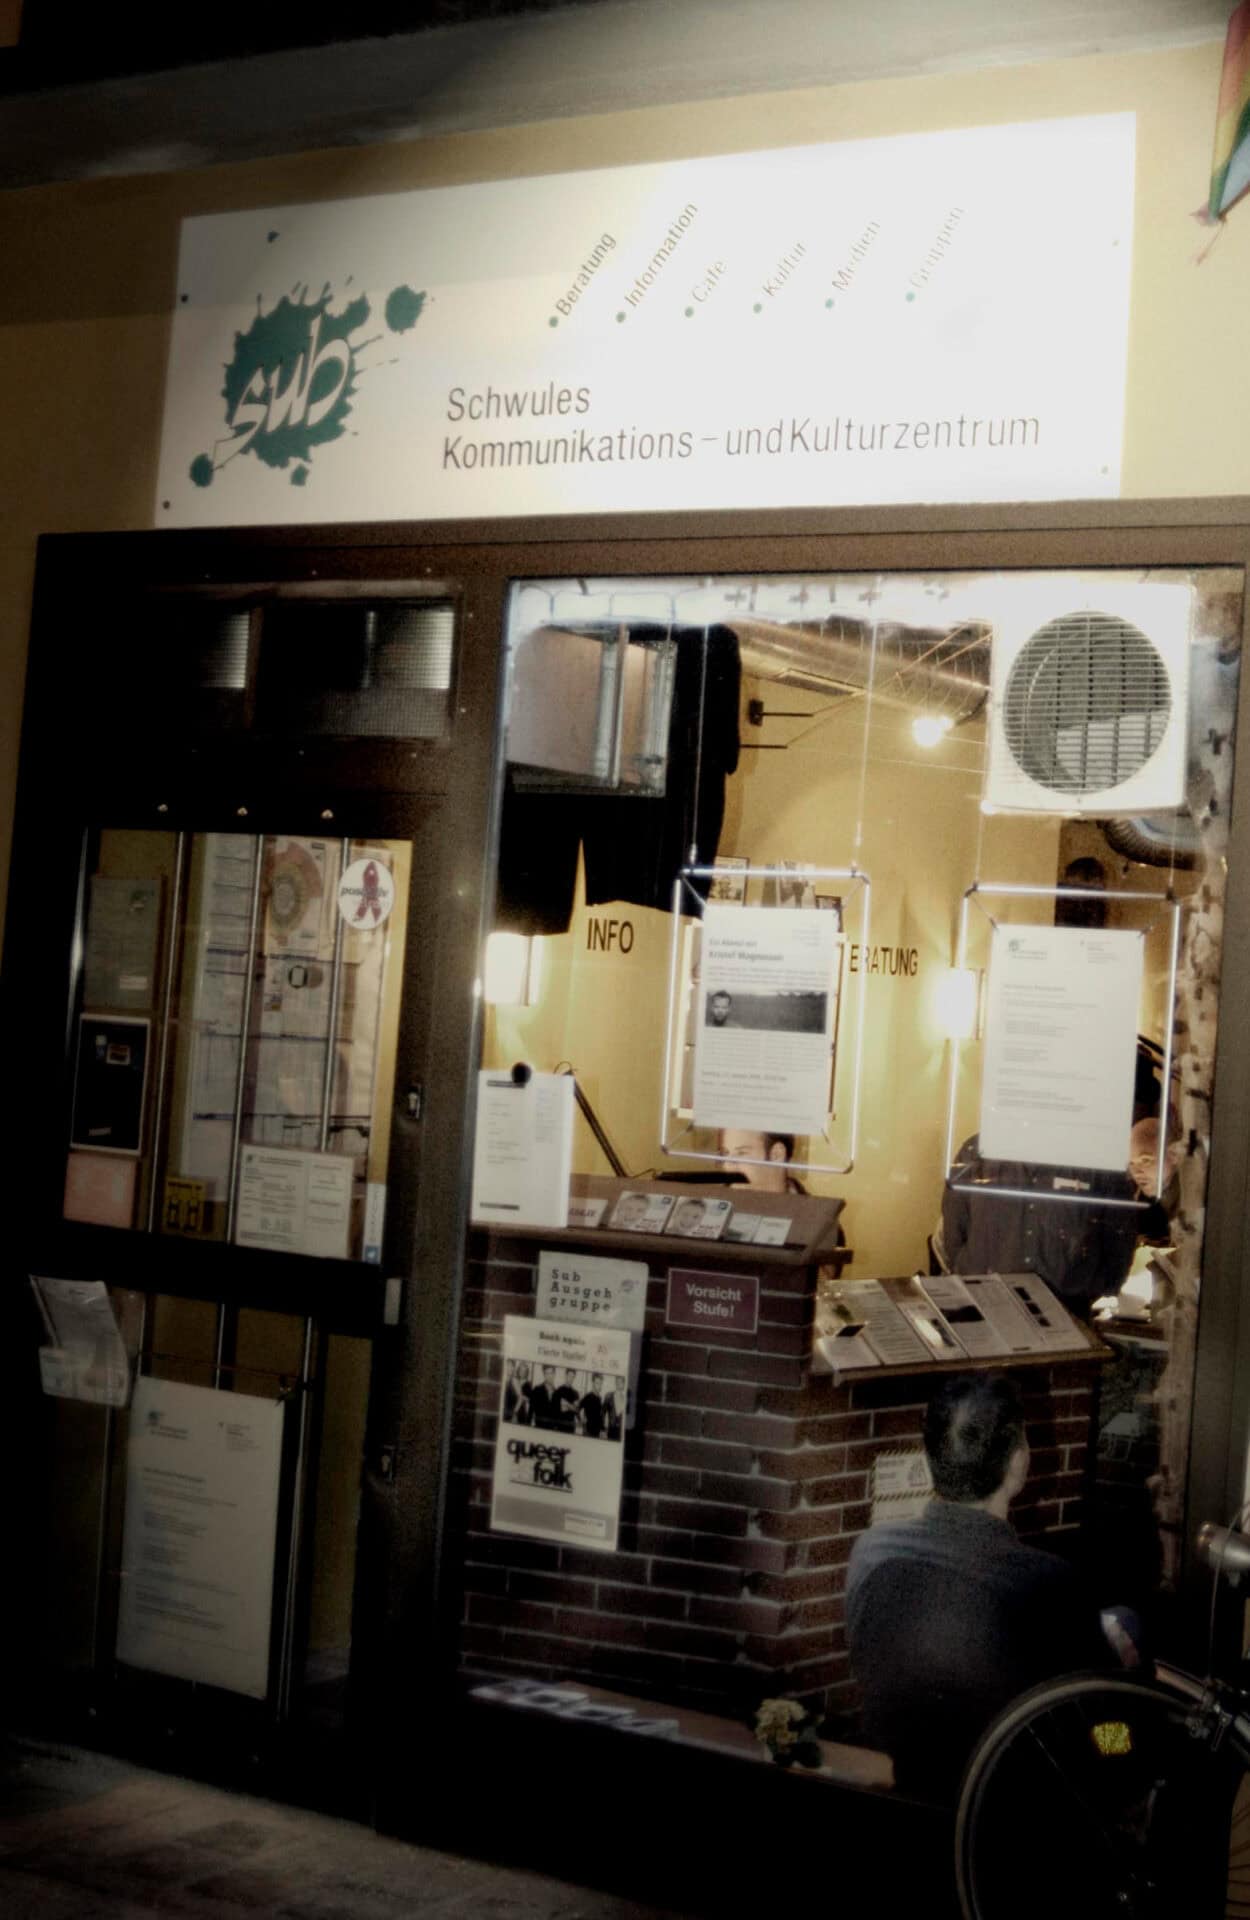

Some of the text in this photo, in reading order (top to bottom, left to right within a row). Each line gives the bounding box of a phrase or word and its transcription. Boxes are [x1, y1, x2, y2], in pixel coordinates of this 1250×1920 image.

[624, 203, 698, 307] Information
[556, 232, 617, 317] Beratung
[228, 319, 352, 441] sub
[446, 382, 591, 421] Schwules
[587, 918, 634, 954] INFO
[551, 1268, 582, 1283] Sub
[550, 1280, 613, 1301] Ausgeh
[686, 1281, 742, 1302] Vorsicht
[549, 1295, 612, 1314] gruppe
[693, 1300, 735, 1318] Stufe!
[507, 1438, 571, 1463] queer
[533, 1462, 572, 1488] folk
